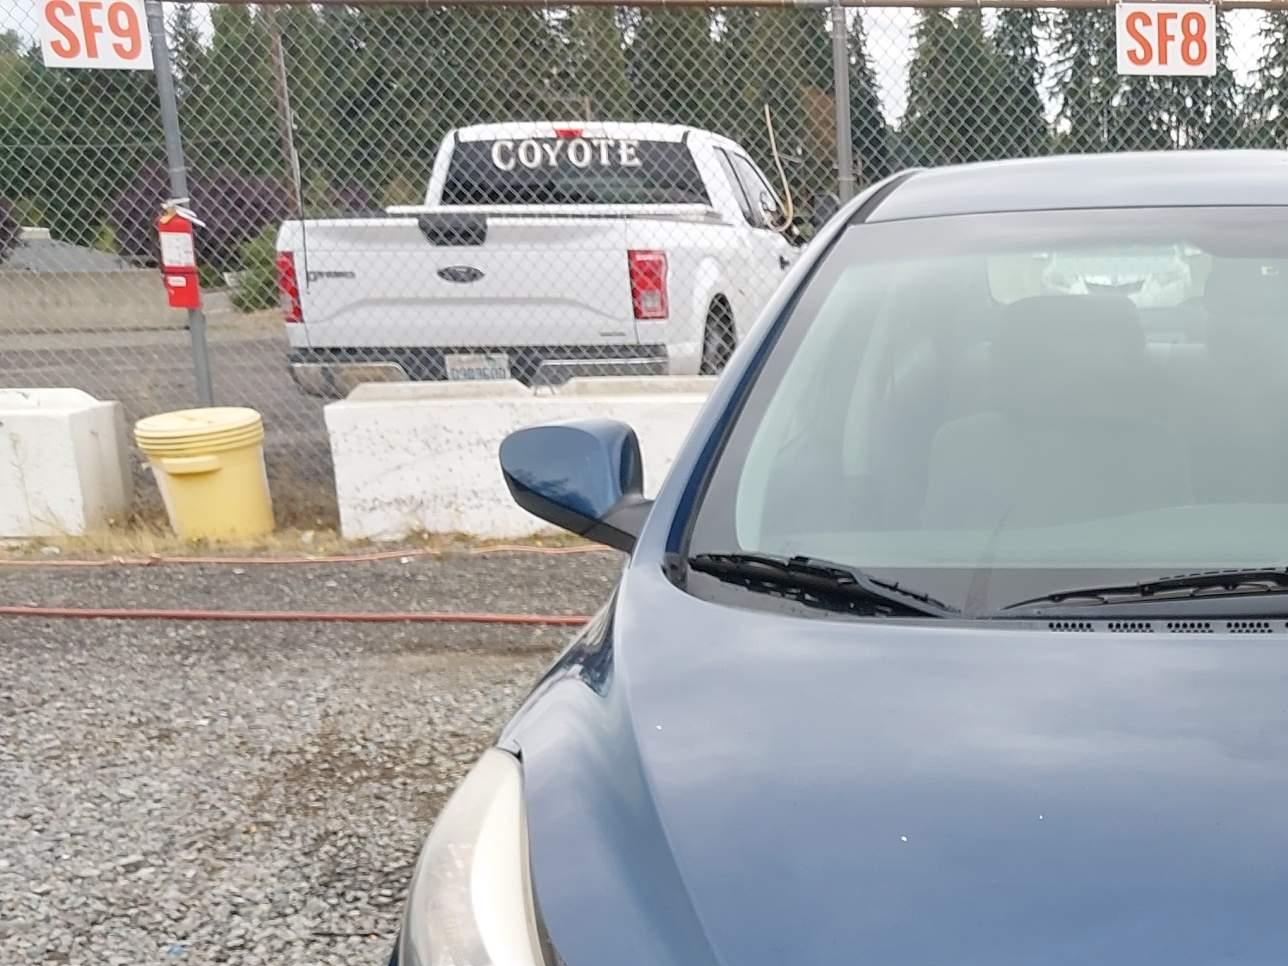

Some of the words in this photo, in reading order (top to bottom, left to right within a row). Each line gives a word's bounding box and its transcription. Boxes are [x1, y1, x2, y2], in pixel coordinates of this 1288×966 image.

[44, 0, 142, 61] SF9
[1125, 11, 1208, 67] SF8
[490, 137, 643, 172] COYOTE
